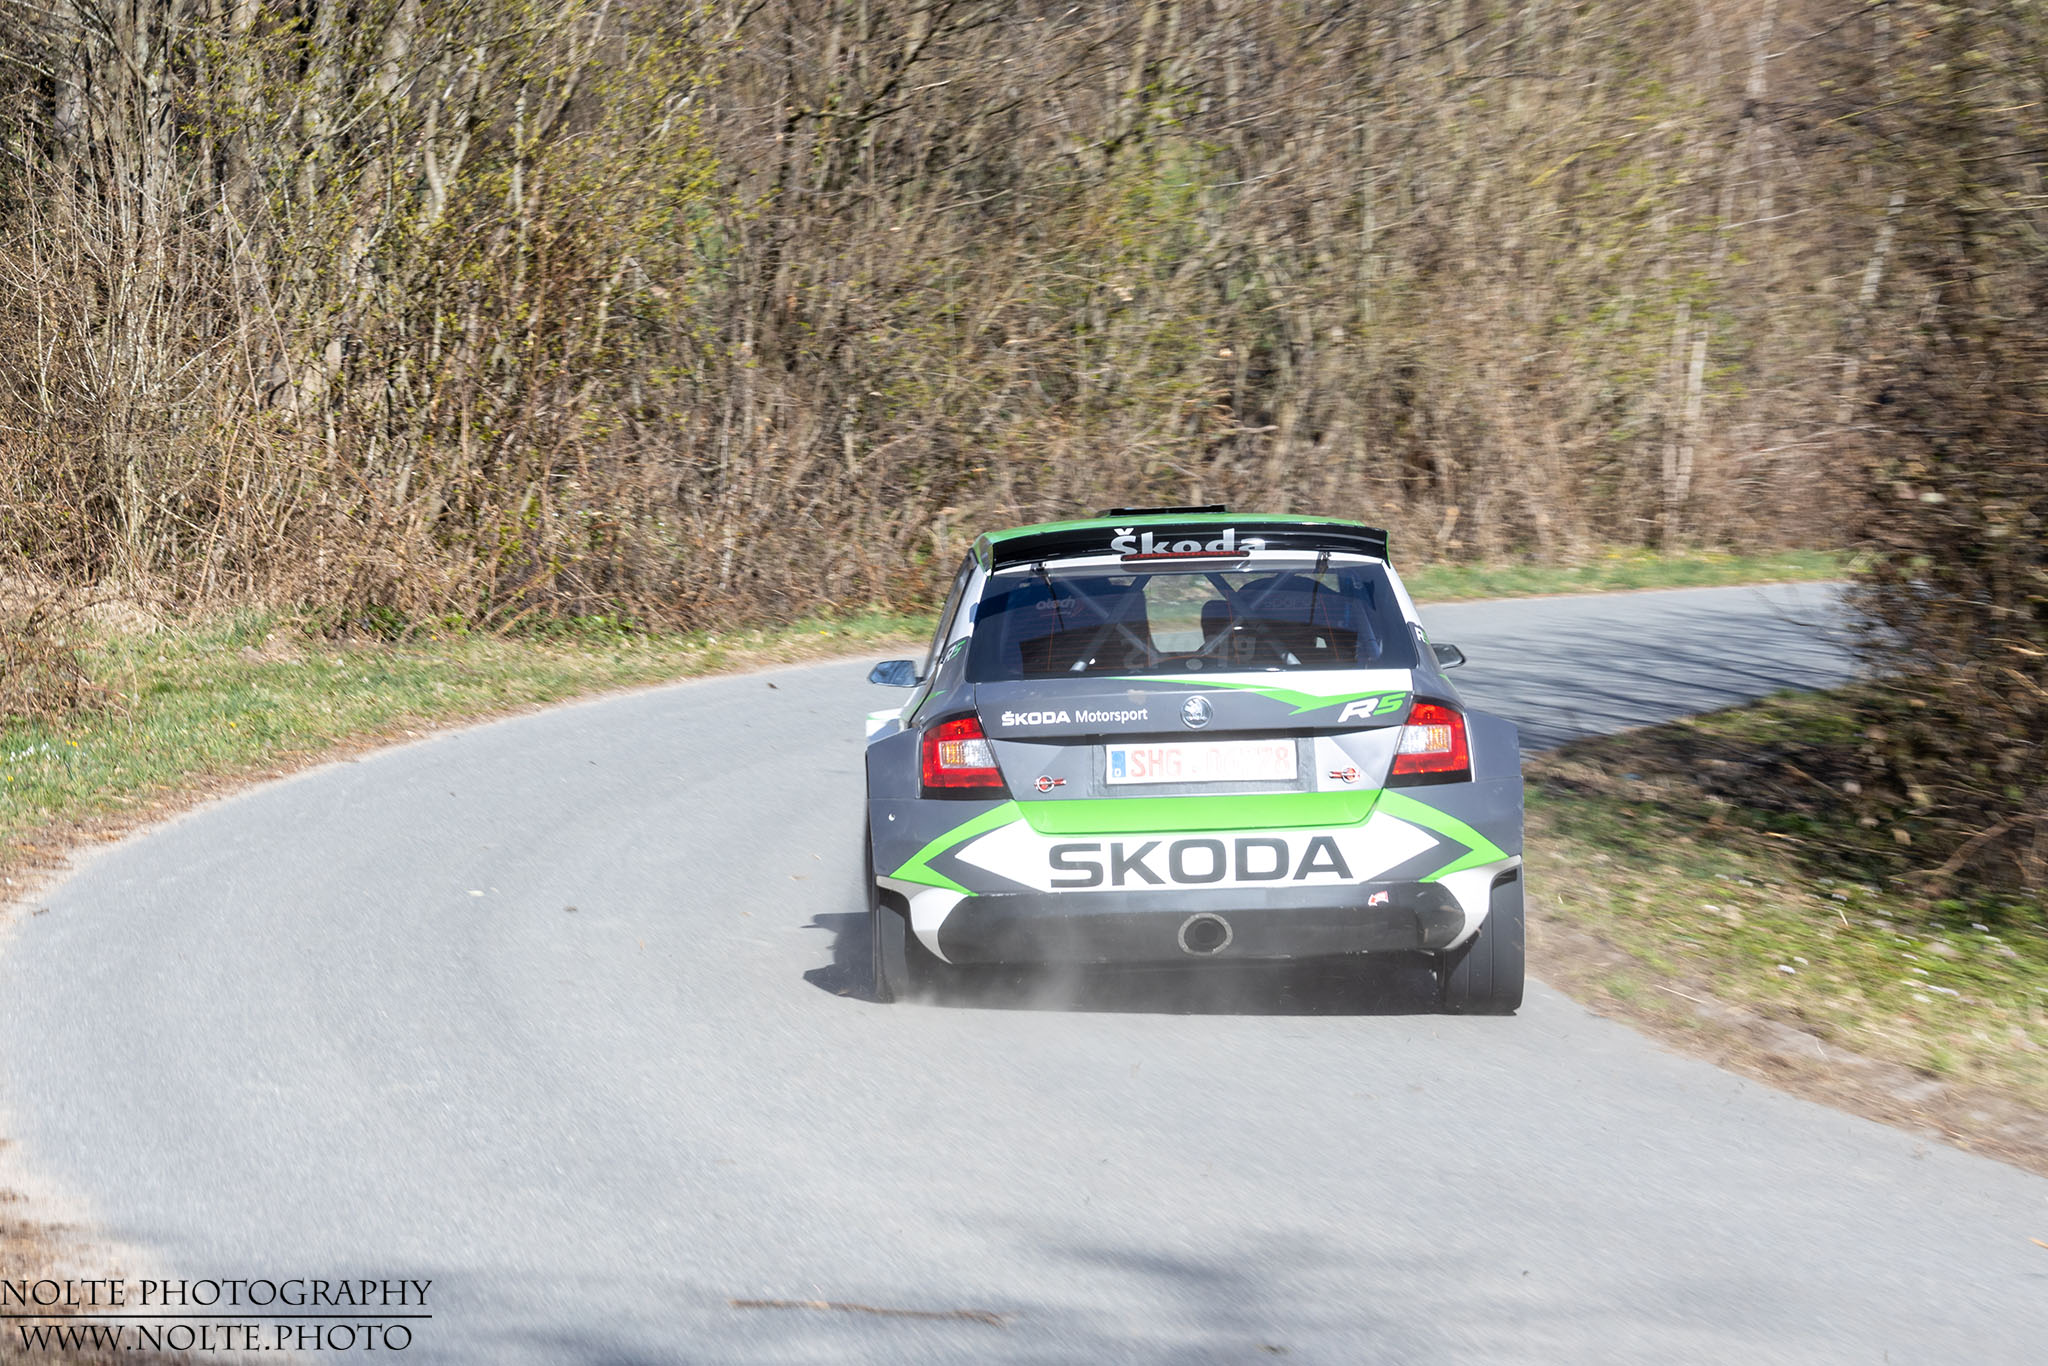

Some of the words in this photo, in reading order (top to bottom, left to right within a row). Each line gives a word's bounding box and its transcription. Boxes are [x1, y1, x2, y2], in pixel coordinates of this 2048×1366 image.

[1001, 711, 1071, 726] ŠKODA
[1075, 708, 1148, 724] Motorsport
[1130, 749, 1184, 777] SHG
[1049, 836, 1354, 888] SKODA
